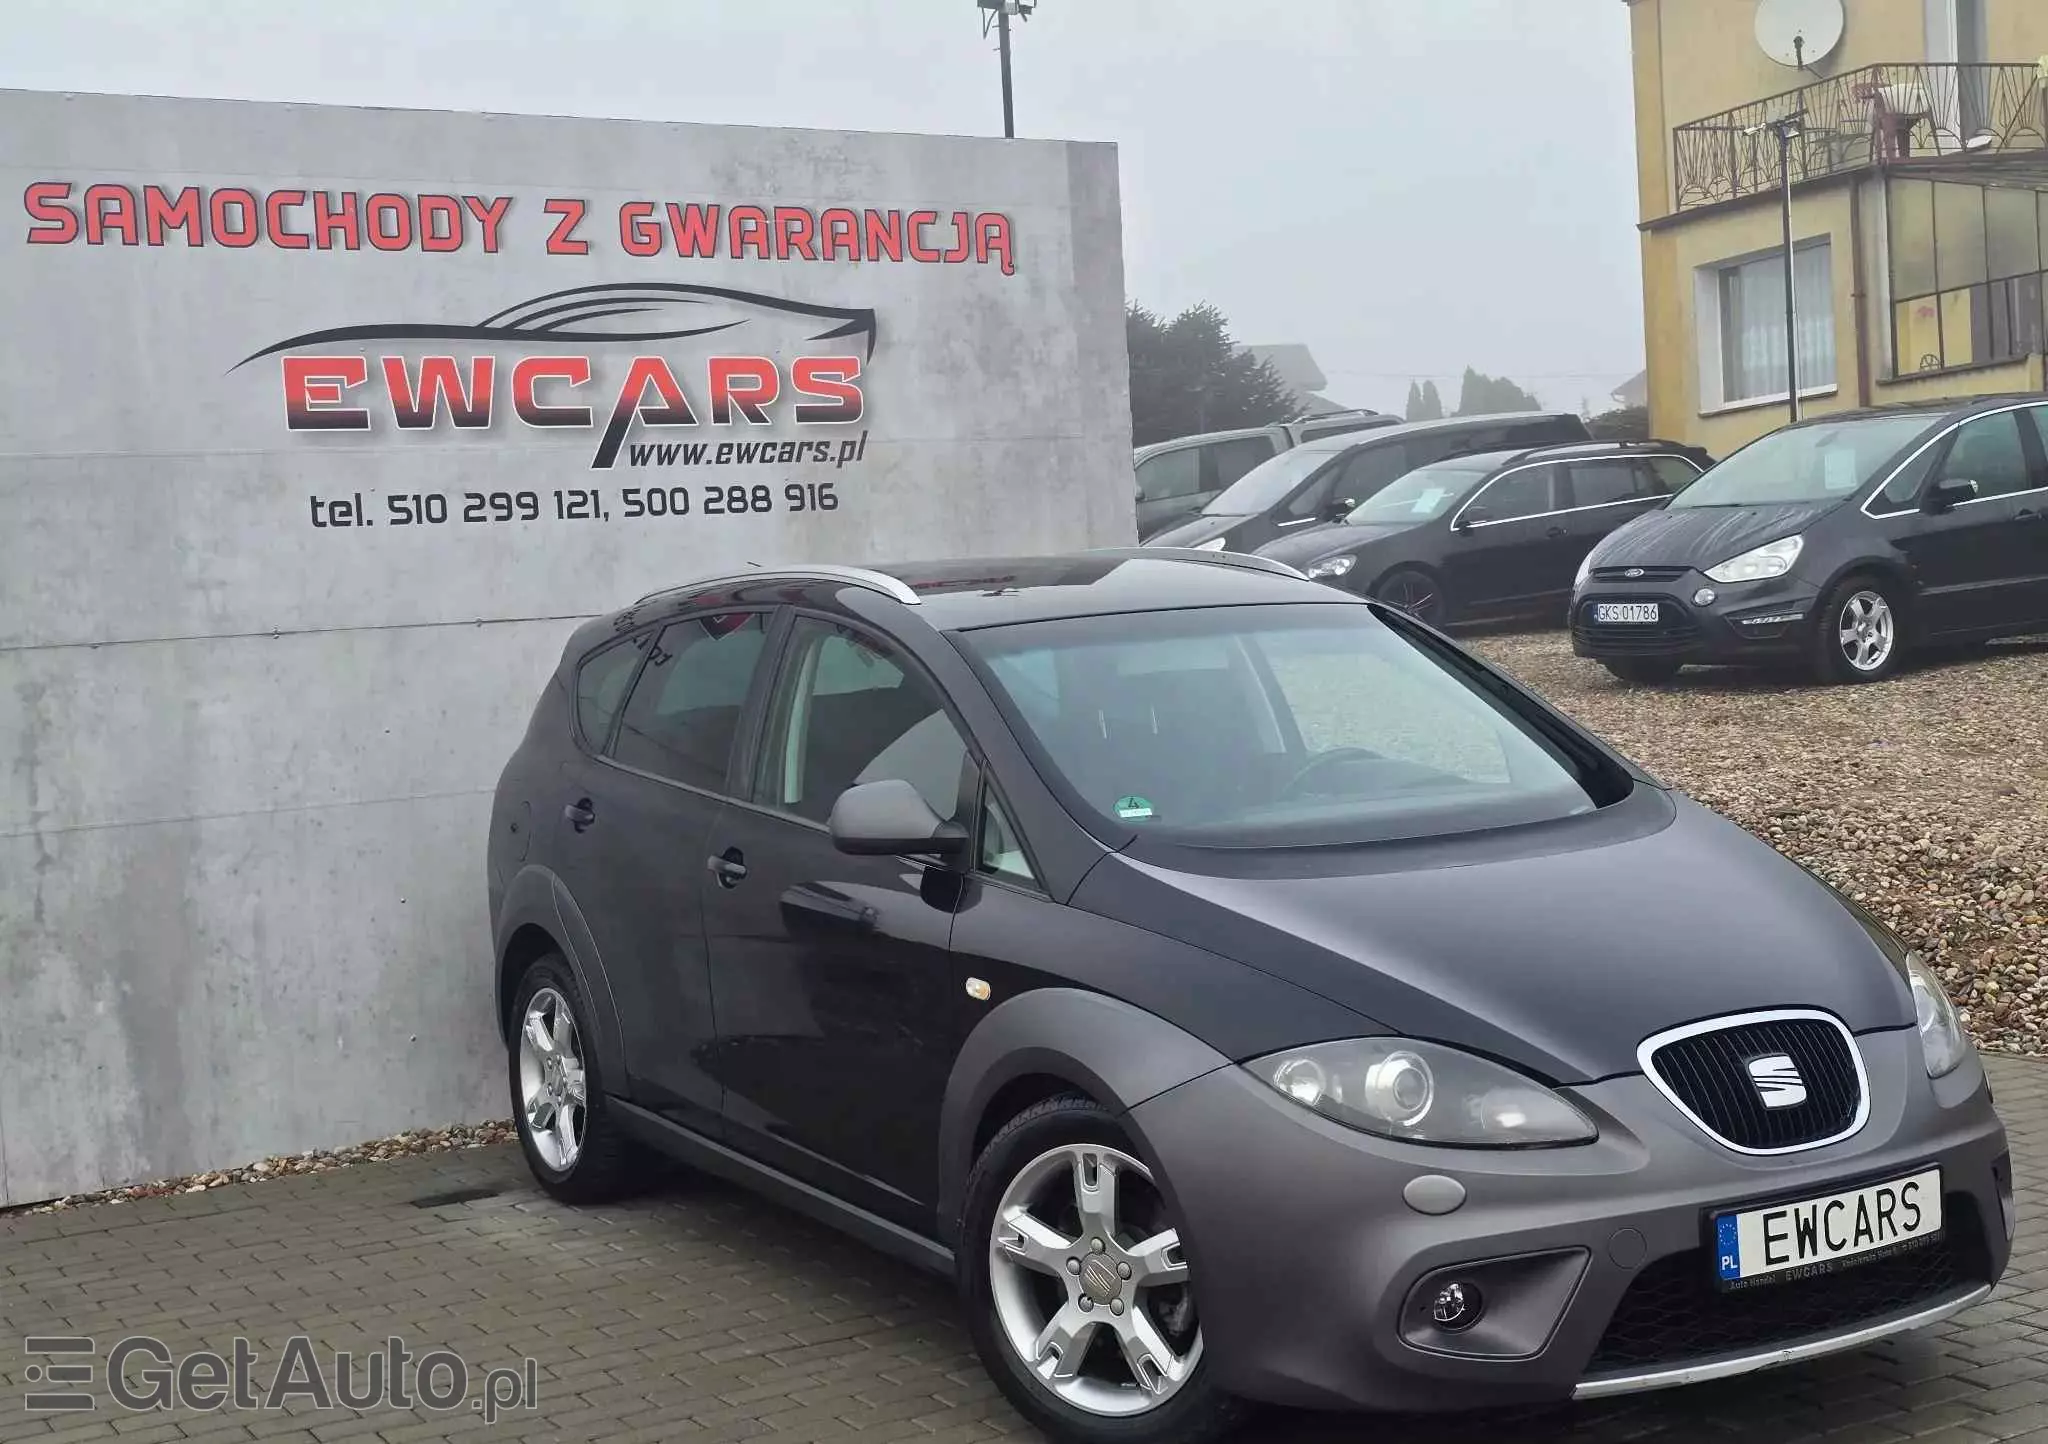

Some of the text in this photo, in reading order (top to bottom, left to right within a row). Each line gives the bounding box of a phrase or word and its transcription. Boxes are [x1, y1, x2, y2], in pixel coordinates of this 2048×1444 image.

[24, 182, 1015, 276] SAMOCHODY Z GWARANCJĄ
[281, 355, 864, 469] EWCARS
[629, 430, 868, 469] www.ewcars.pl
[311, 483, 839, 528] tel. 510 299 121, 500 288 916
[1598, 605, 1657, 621] GKS 01786
[1721, 1255, 1738, 1271] PL
[1762, 1181, 1921, 1266] EWCARS
[1784, 1262, 1834, 1281] EWCARS
